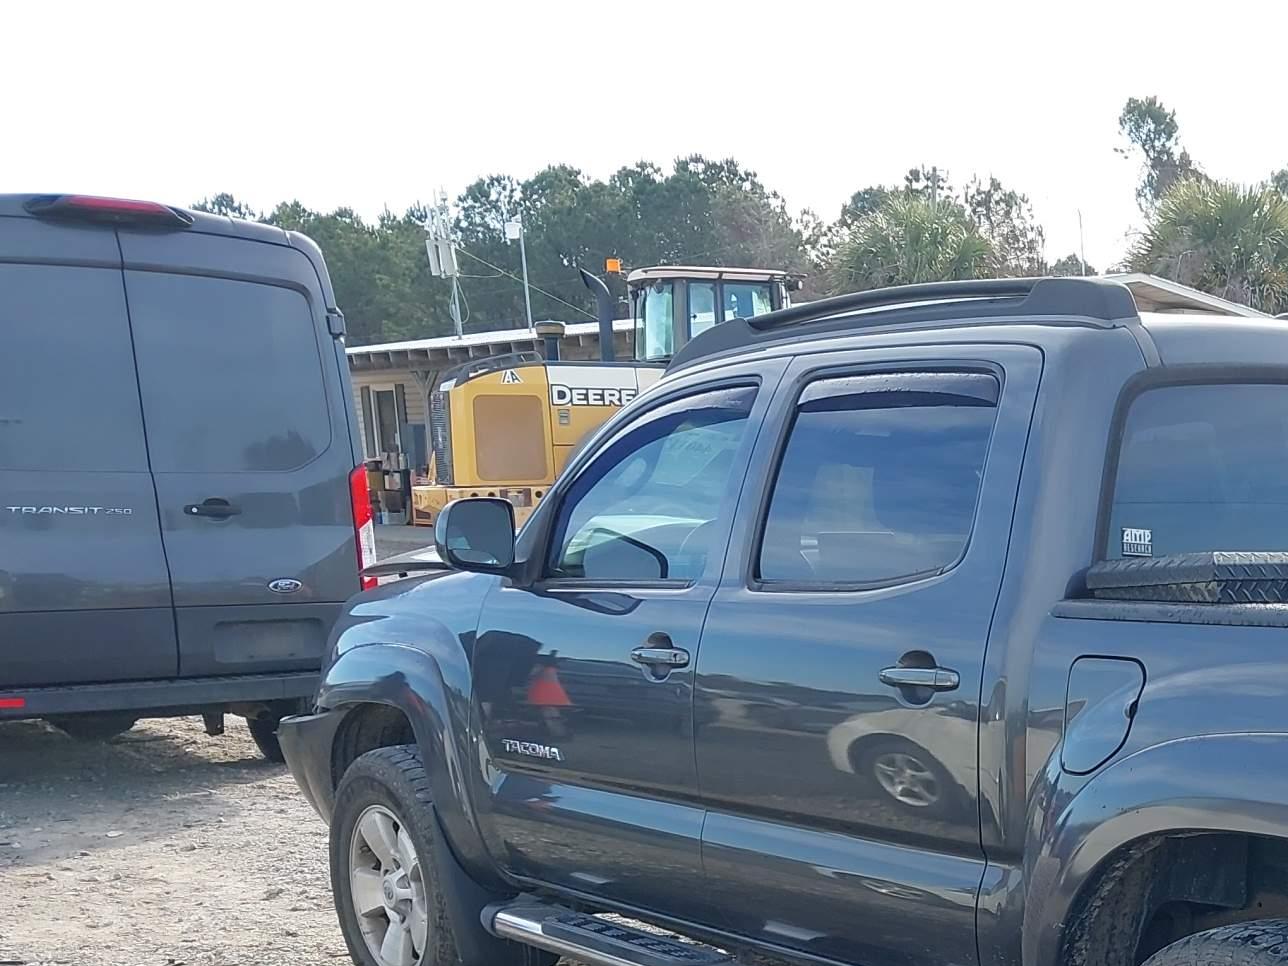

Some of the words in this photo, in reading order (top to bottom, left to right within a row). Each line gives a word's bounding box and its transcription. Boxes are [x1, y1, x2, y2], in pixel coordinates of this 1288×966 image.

[550, 384, 638, 406] DEERE
[6, 506, 103, 515] TRANSIT
[1123, 529, 1152, 543] AMP
[501, 739, 561, 760] TACOMA
